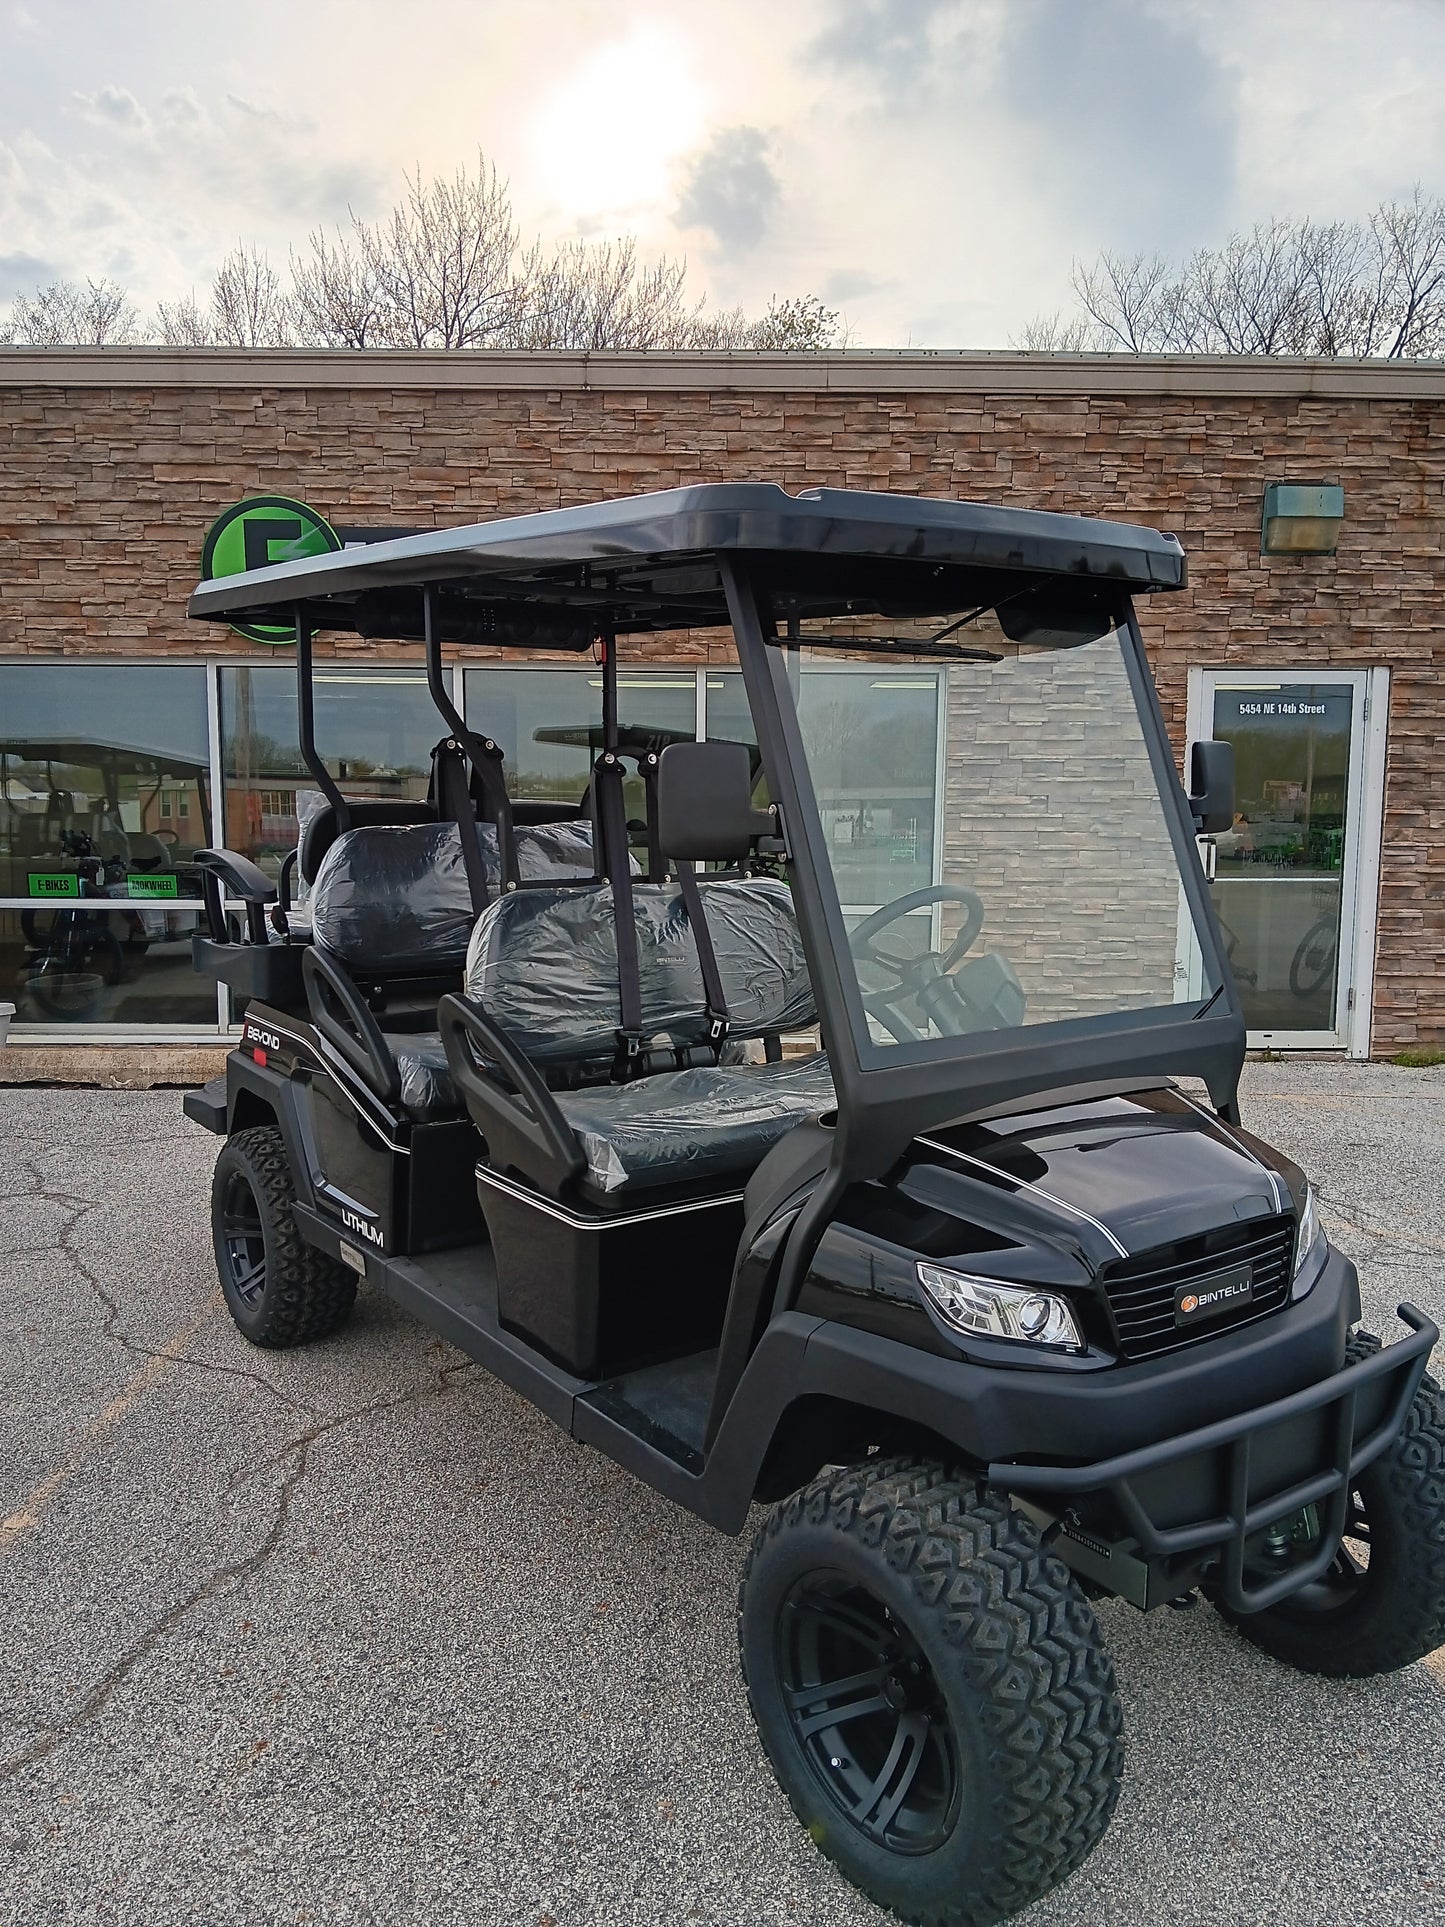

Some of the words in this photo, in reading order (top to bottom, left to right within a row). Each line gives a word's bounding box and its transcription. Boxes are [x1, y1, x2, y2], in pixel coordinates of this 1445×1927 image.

[1239, 703, 1262, 715] 5454
[1263, 703, 1275, 714] NE
[1277, 703, 1297, 714] 14th
[1298, 703, 1326, 714] Street
[37, 879, 70, 891] E-BIKES
[247, 1025, 280, 1050] BEYOND
[341, 1208, 384, 1248] LITHIUM
[1198, 1280, 1250, 1306] BINTELLI
